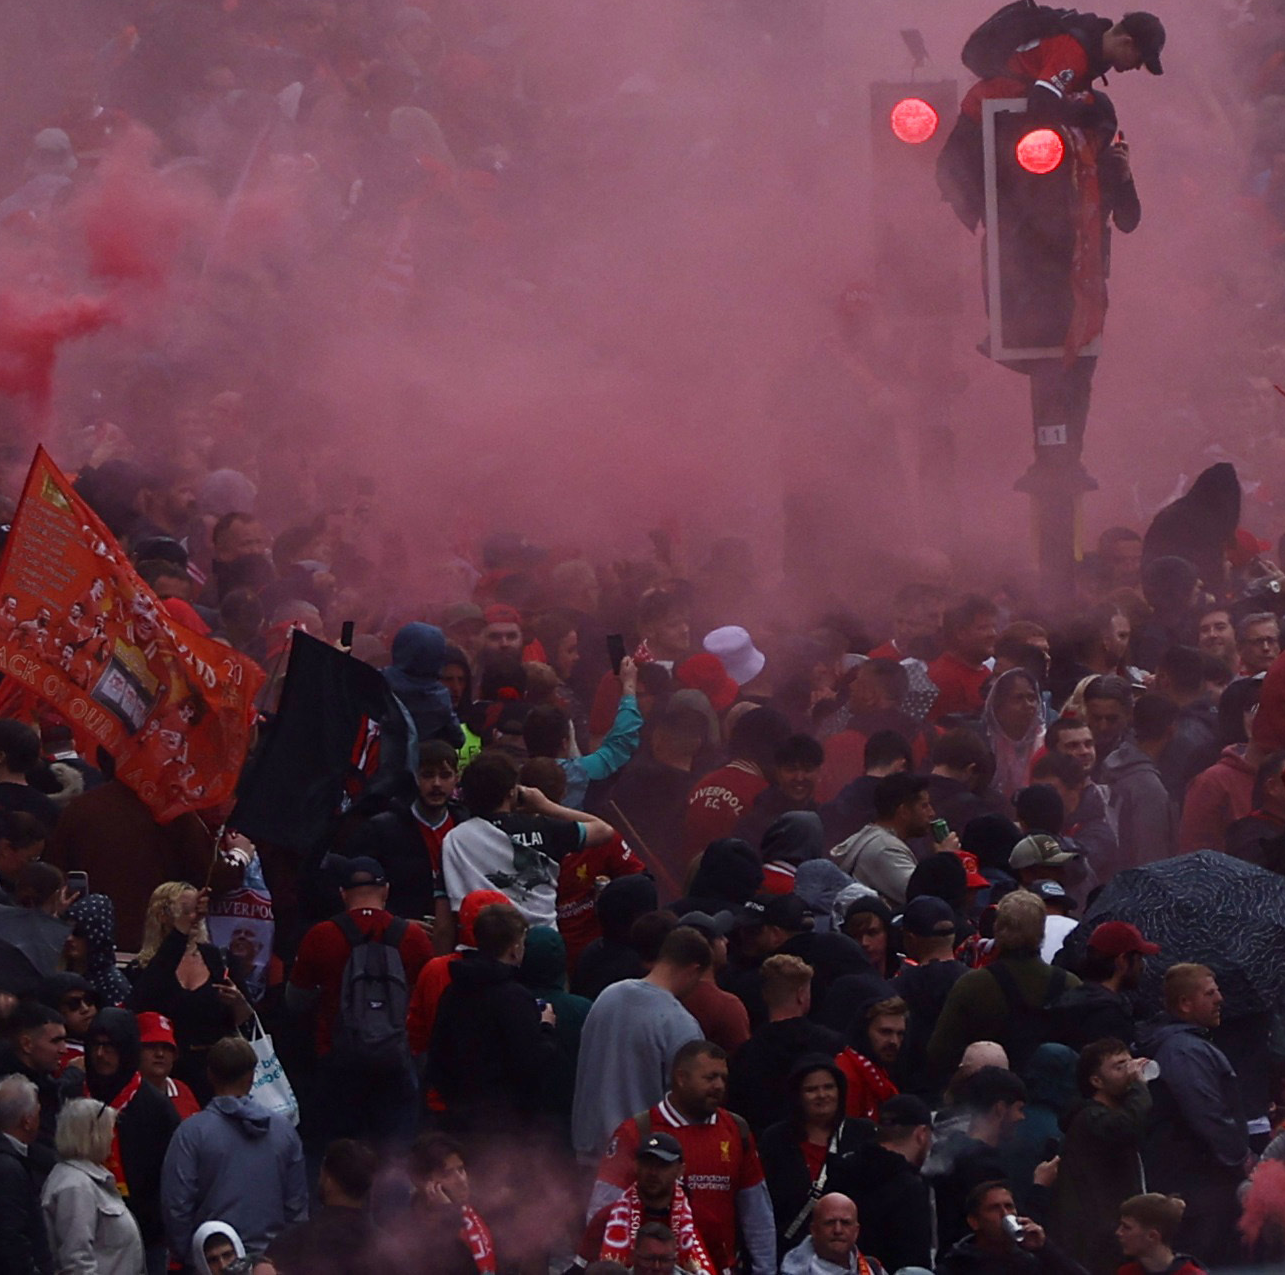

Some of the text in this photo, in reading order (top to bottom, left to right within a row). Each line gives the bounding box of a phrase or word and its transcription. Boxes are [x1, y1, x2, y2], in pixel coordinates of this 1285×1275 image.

[689, 786, 744, 817] LIVERPOOL
[688, 1174, 731, 1183] standard
[687, 1182, 731, 1191] chartered
